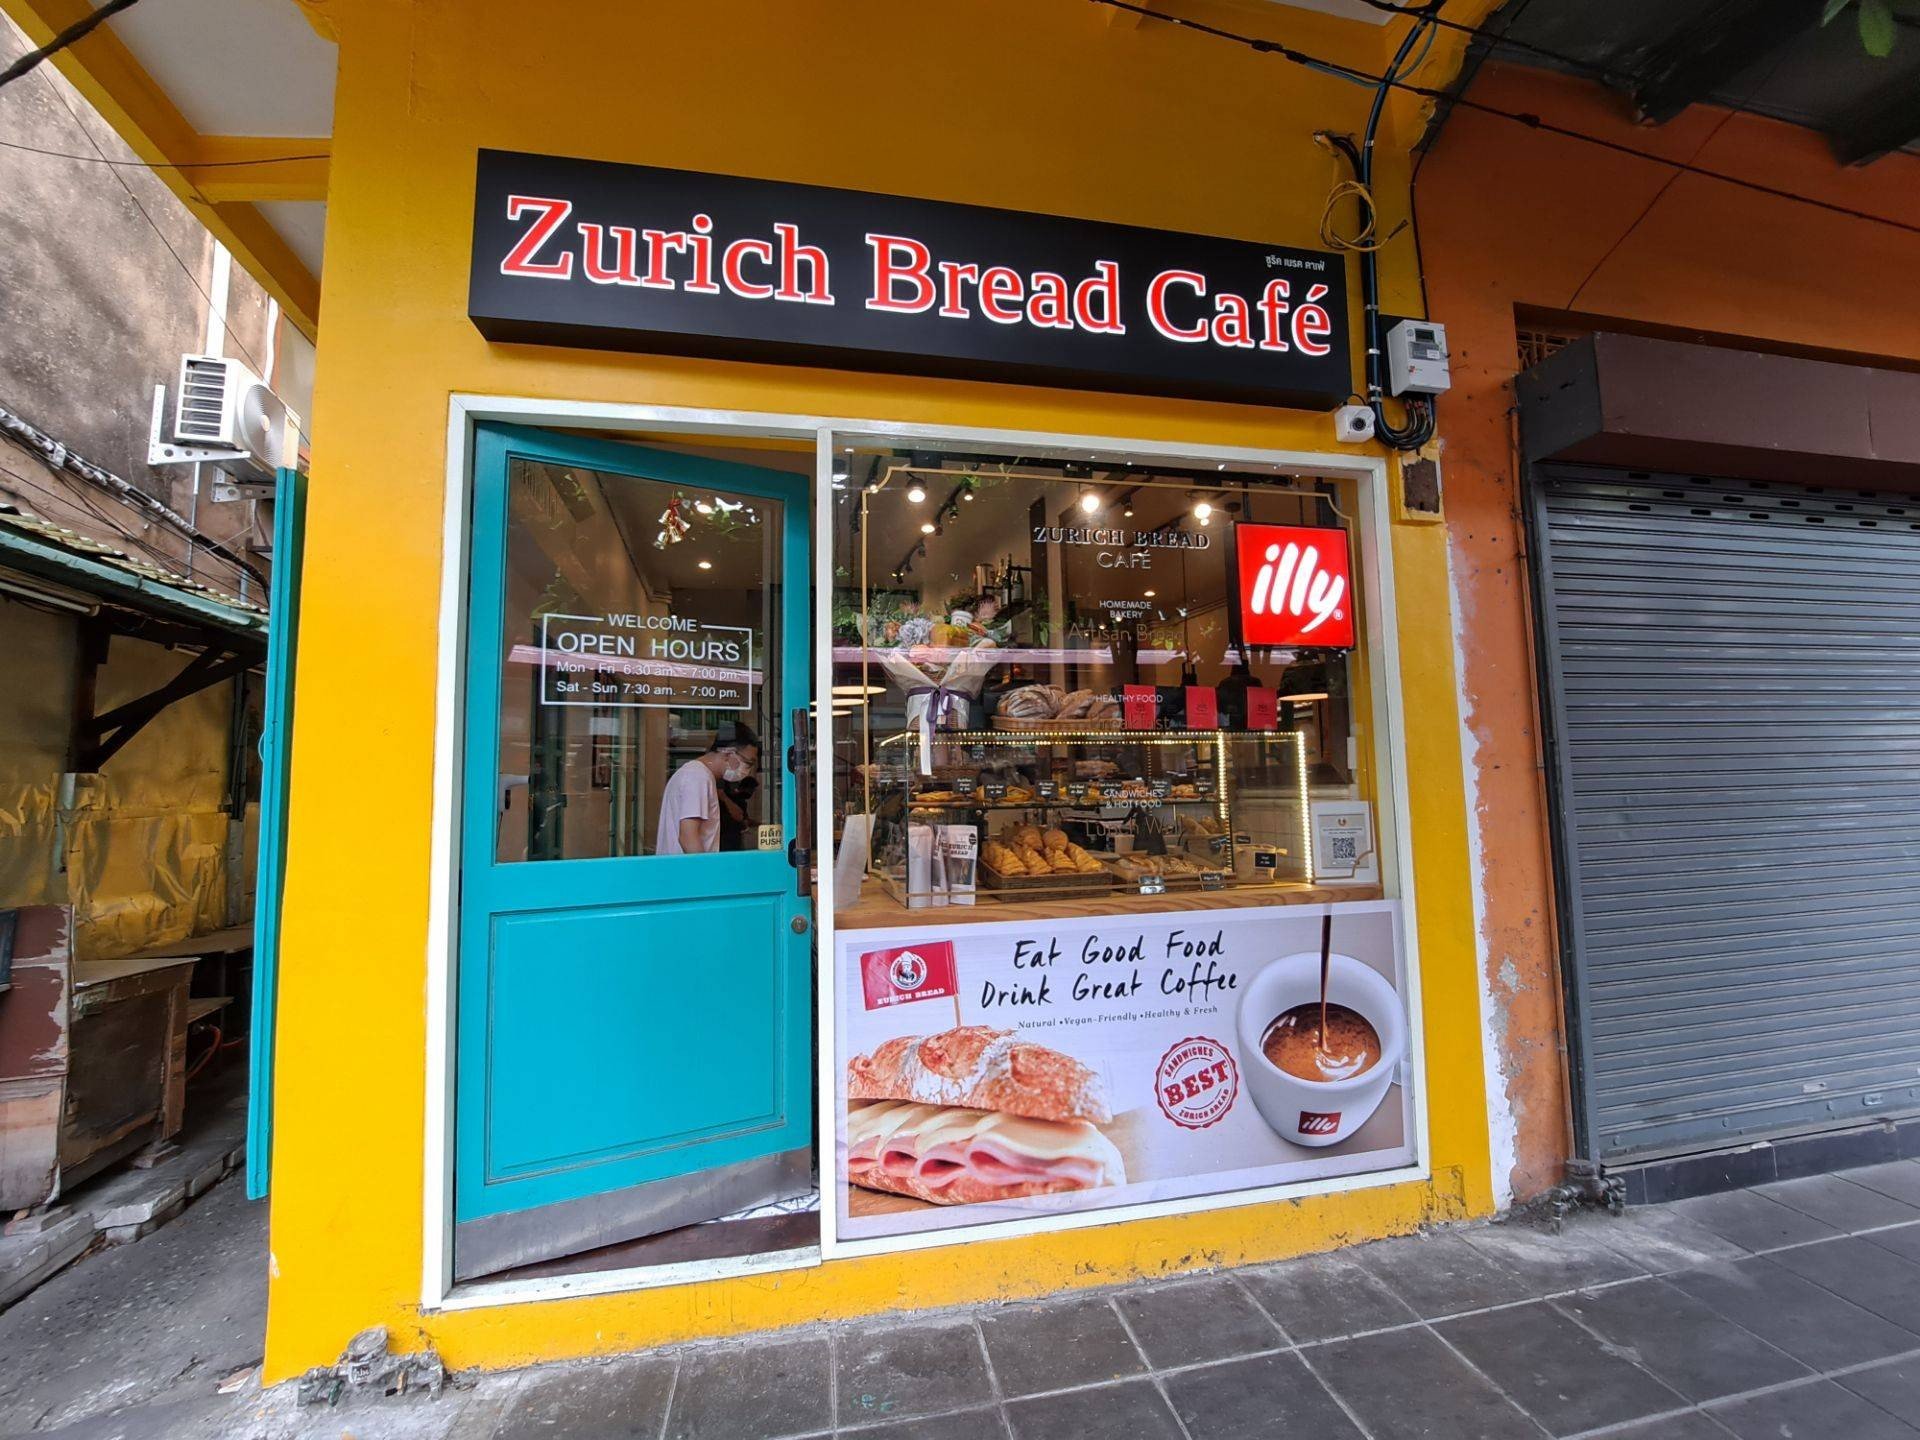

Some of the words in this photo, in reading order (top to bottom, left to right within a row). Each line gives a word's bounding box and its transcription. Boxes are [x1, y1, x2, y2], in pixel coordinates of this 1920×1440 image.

[500, 195, 835, 306] Zurich
[865, 233, 1126, 335] Bread
[1146, 269, 1331, 356] Café
[1033, 526, 1124, 546] ZURICH
[1134, 530, 1210, 550] BREAD
[1096, 550, 1152, 569] CAFÉ
[1251, 542, 1345, 633] illy
[1099, 600, 1152, 609] HOMEMADE
[1110, 610, 1143, 618] BAKERY
[608, 613, 698, 632] WELCOME
[1067, 622, 1131, 641] Artisan
[557, 632, 635, 656] OPEN
[651, 638, 740, 662] HOURS
[556, 661, 586, 673] Mon
[598, 662, 615, 674] Fri
[623, 664, 650, 676] 6:30
[691, 667, 716, 678] 7:00
[556, 680, 580, 693] Sat
[591, 681, 618, 693] Sun
[623, 683, 650, 695] 7:30
[654, 686, 676, 696] am.
[691, 685, 716, 697] 7:00
[719, 689, 740, 699] pm.
[1095, 694, 1134, 702] HEALTHY
[1137, 694, 1164, 703] FOOD
[1103, 789, 1164, 798] SANDWICHES
[1114, 800, 1134, 808] HOT
[1135, 800, 1162, 808] FOOD
[760, 838, 781, 846] PUSH
[1013, 936, 1062, 969] Eat
[1081, 934, 1146, 964] Good
[1166, 929, 1225, 959] Food
[915, 988, 945, 998] BREAD
[981, 973, 1053, 1009] Drink
[1072, 968, 1143, 1001] Great
[1160, 960, 1238, 1002] Coffee
[1018, 1018, 1056, 1029] Natural
[1183, 1007, 1191, 1016] &
[1193, 1005, 1218, 1015] Fresh
[1164, 1046, 1214, 1077] SANDWICHES
[1163, 1059, 1229, 1107] BEST
[1179, 1109, 1209, 1120] ZURICH
[1209, 1089, 1229, 1114] BREAD
[1301, 1116, 1337, 1133] illy
